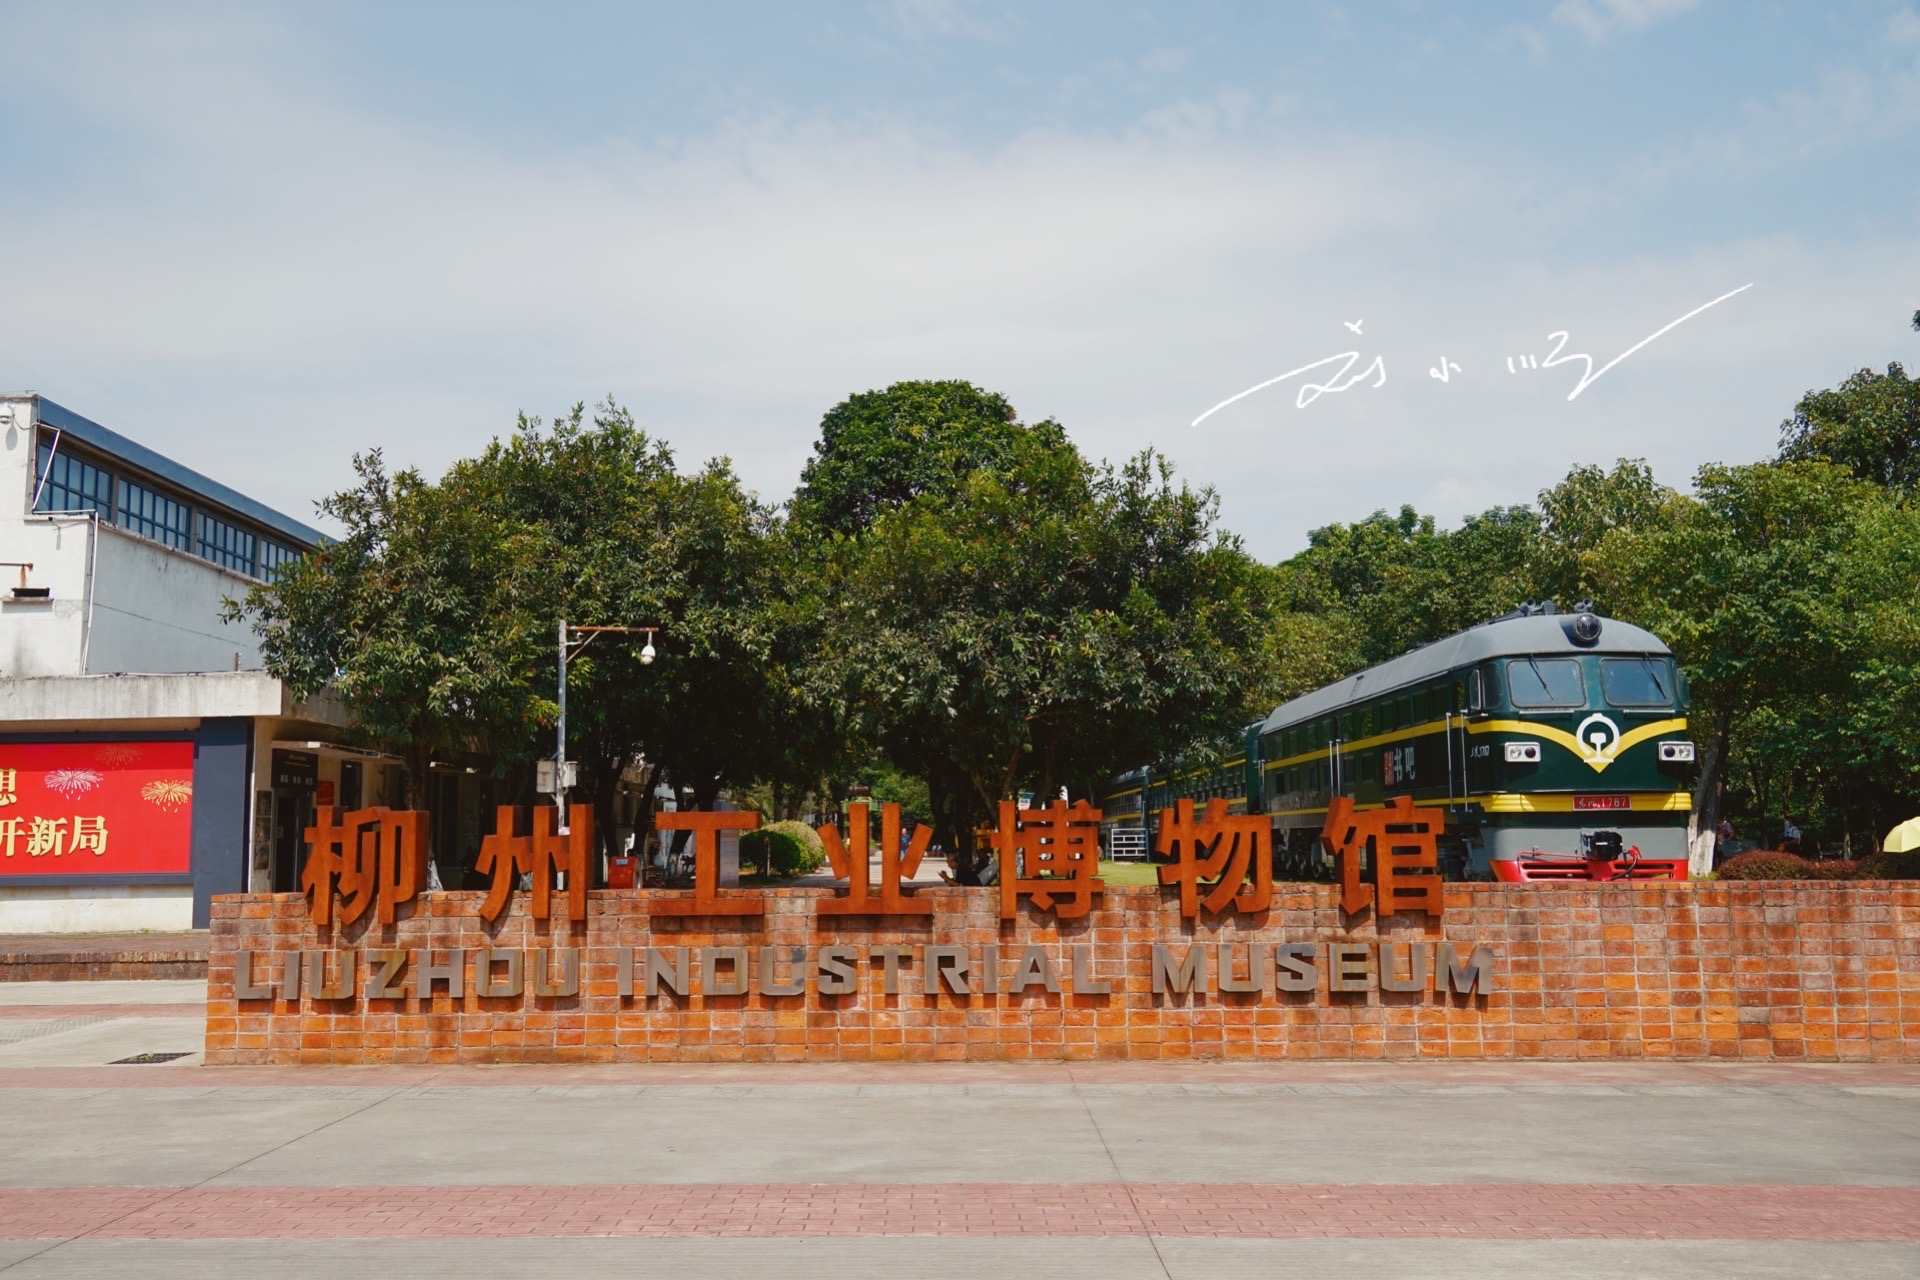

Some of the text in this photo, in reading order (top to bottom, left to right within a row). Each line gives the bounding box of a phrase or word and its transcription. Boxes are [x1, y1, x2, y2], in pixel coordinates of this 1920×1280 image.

[0, 815, 109, 857] 开新局
[302, 796, 1444, 926] 柳州工业博物馆
[235, 942, 1494, 1001] LIUZHOU INDUSTRIAL MUSEUM
